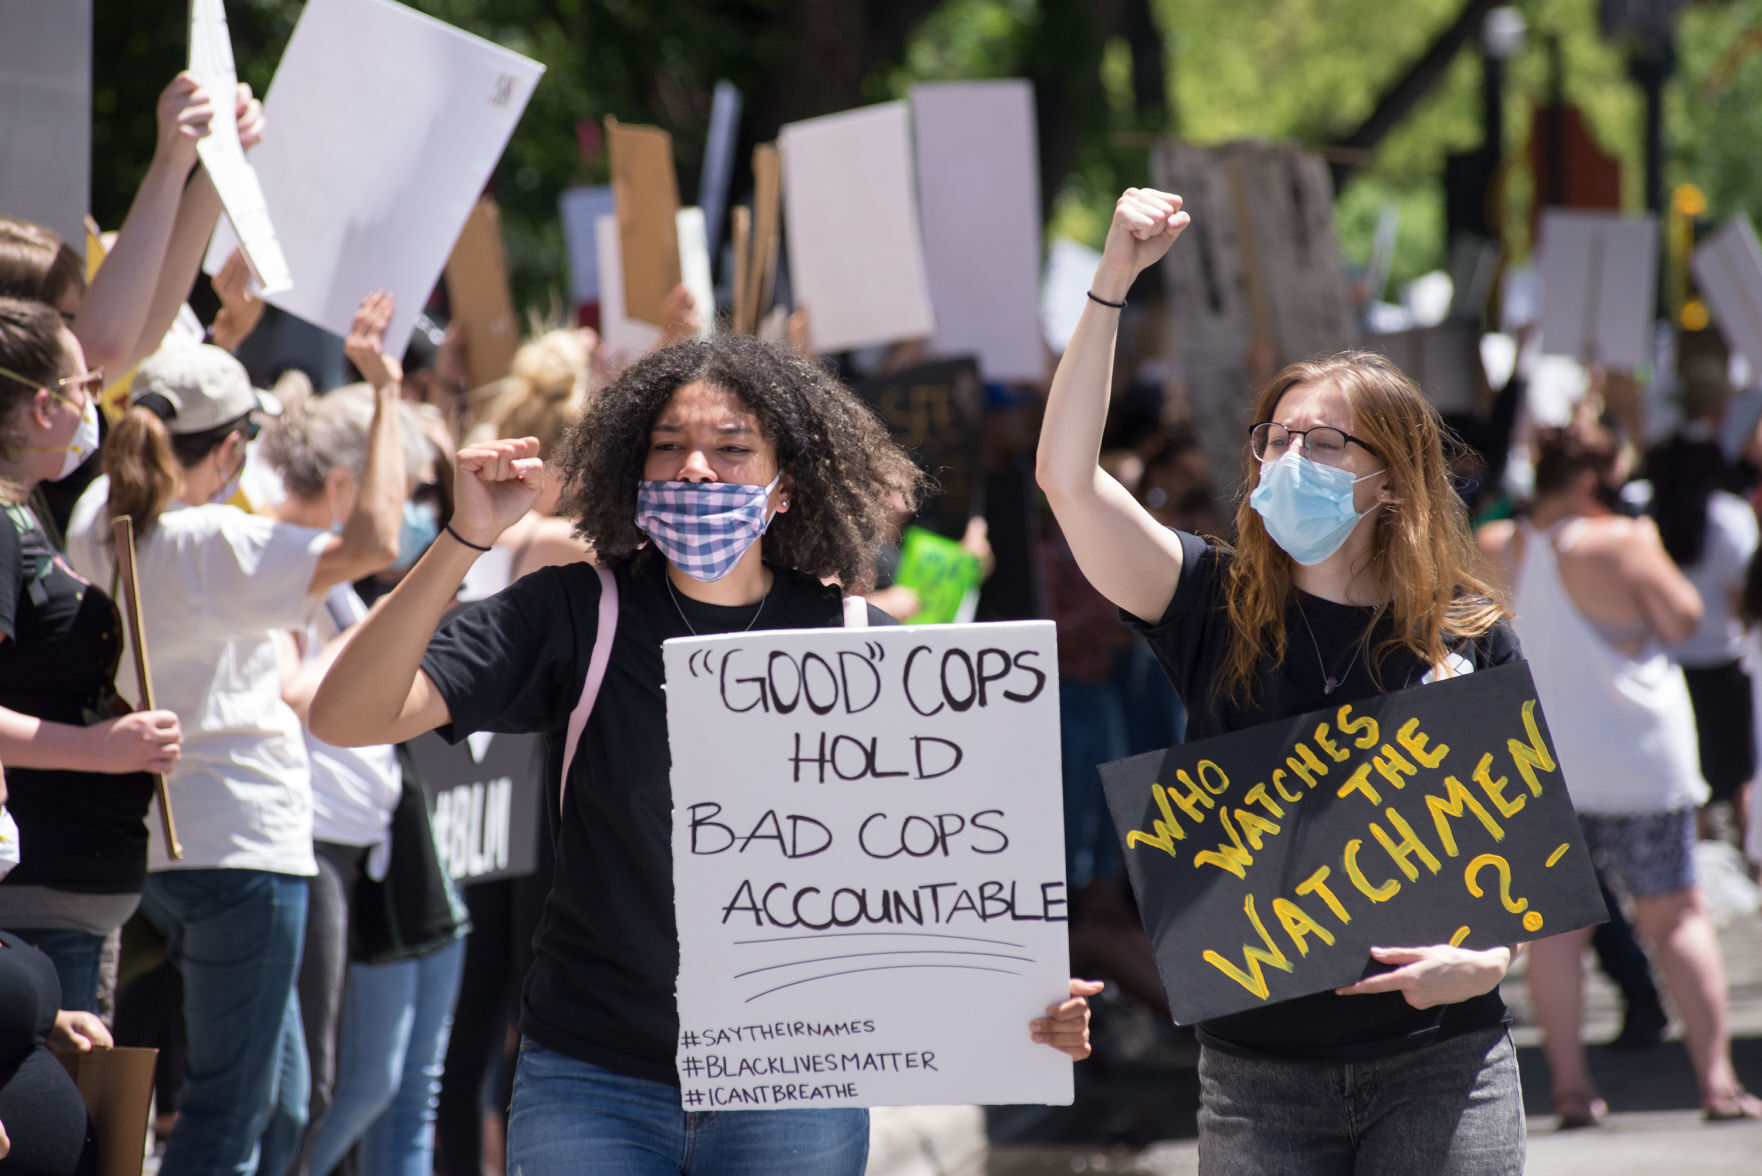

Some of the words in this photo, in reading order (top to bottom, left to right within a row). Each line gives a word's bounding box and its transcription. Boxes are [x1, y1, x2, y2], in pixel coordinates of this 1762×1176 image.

[903, 646, 1046, 716] COPS
[789, 732, 963, 783] HOLD
[1337, 718, 1450, 806] THE
[1126, 760, 1229, 857] WHO
[1194, 704, 1380, 880] WATCHES
[687, 802, 832, 858] BAD
[859, 810, 1008, 859] COPS
[1203, 699, 1556, 1000] WATCHMEN
[722, 878, 1067, 930] ACCOUNTABLE
[1465, 854, 1543, 932] ?
[680, 1020, 875, 1049] #SAYTHEIRNAMES
[682, 1052, 938, 1078] #BLACKLIVESMATTER
[684, 1083, 859, 1106] #ICANTBREATHE
